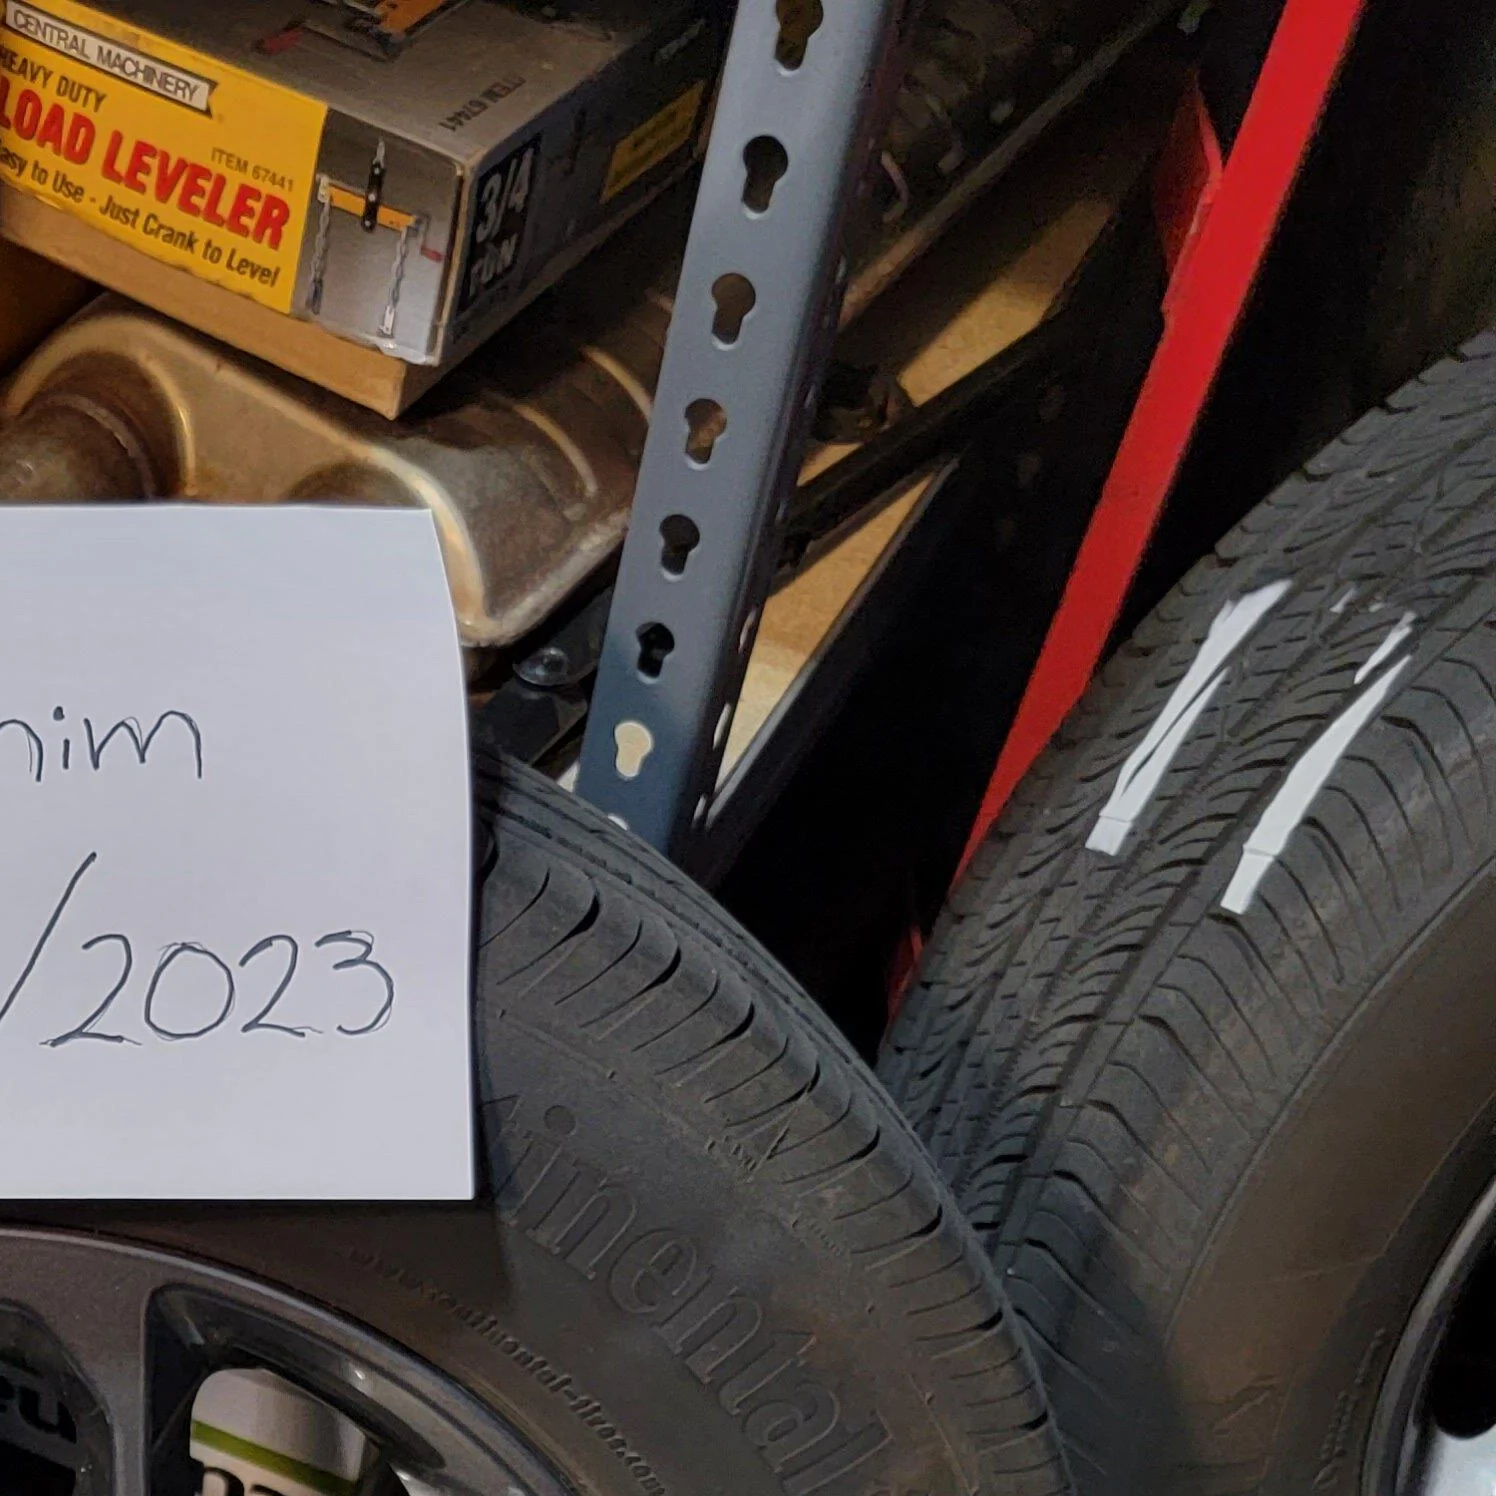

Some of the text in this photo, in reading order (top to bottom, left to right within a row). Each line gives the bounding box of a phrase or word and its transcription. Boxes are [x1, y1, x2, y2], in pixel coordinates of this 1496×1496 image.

[13, 10, 202, 102] CENTRAL MACHINERY
[56, 76, 107, 113] DUTY
[101, 130, 291, 251] LEVELER
[211, 148, 294, 193] ITEM 67441
[476, 148, 535, 244] 3/4
[31, 160, 49, 185] to
[53, 175, 85, 205] Use
[99, 196, 141, 230] Just
[141, 213, 199, 253] Crank
[202, 239, 222, 265] to
[226, 250, 280, 288] Level
